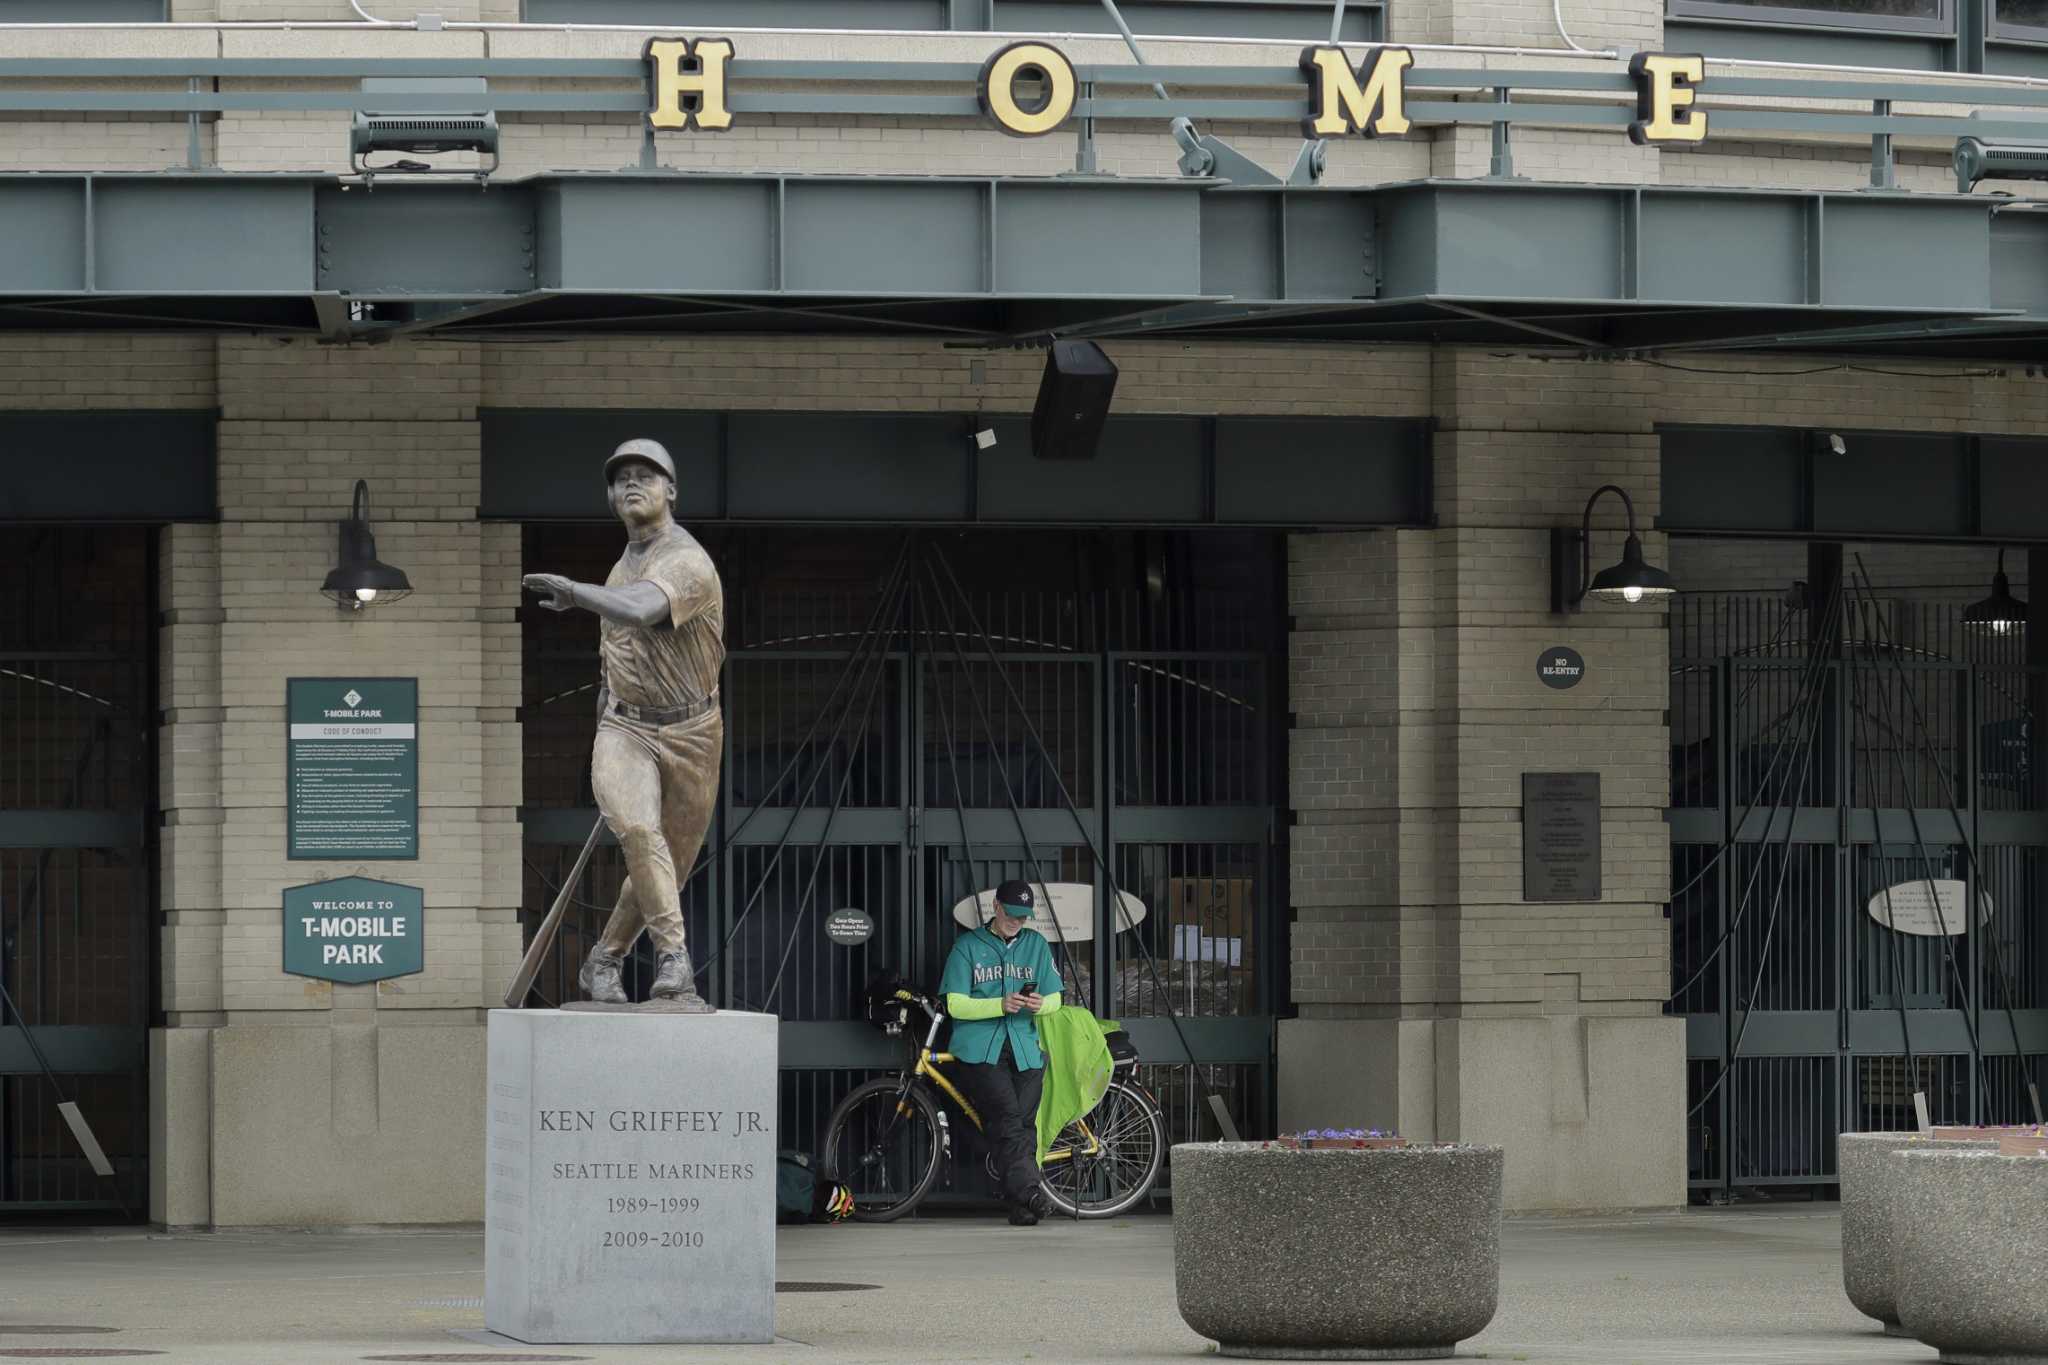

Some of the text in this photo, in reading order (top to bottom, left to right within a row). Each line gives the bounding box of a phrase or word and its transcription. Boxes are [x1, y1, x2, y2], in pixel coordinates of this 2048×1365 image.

[642, 36, 1708, 144] HOME
[1555, 658, 1567, 666] NO
[1543, 667, 1580, 675] RE-ENTRY
[323, 710, 382, 718] T-MOBILE PARK
[312, 901, 393, 910] WELCOME TO
[301, 917, 406, 937] T-MOBILE
[323, 944, 384, 965] PARK
[540, 1111, 770, 1137] KEN GRIFFEY JR.
[553, 1163, 755, 1180] SEATTLE MARINERS
[607, 1197, 701, 1214] 1989-1999
[602, 1231, 704, 1248] 2009-2010
